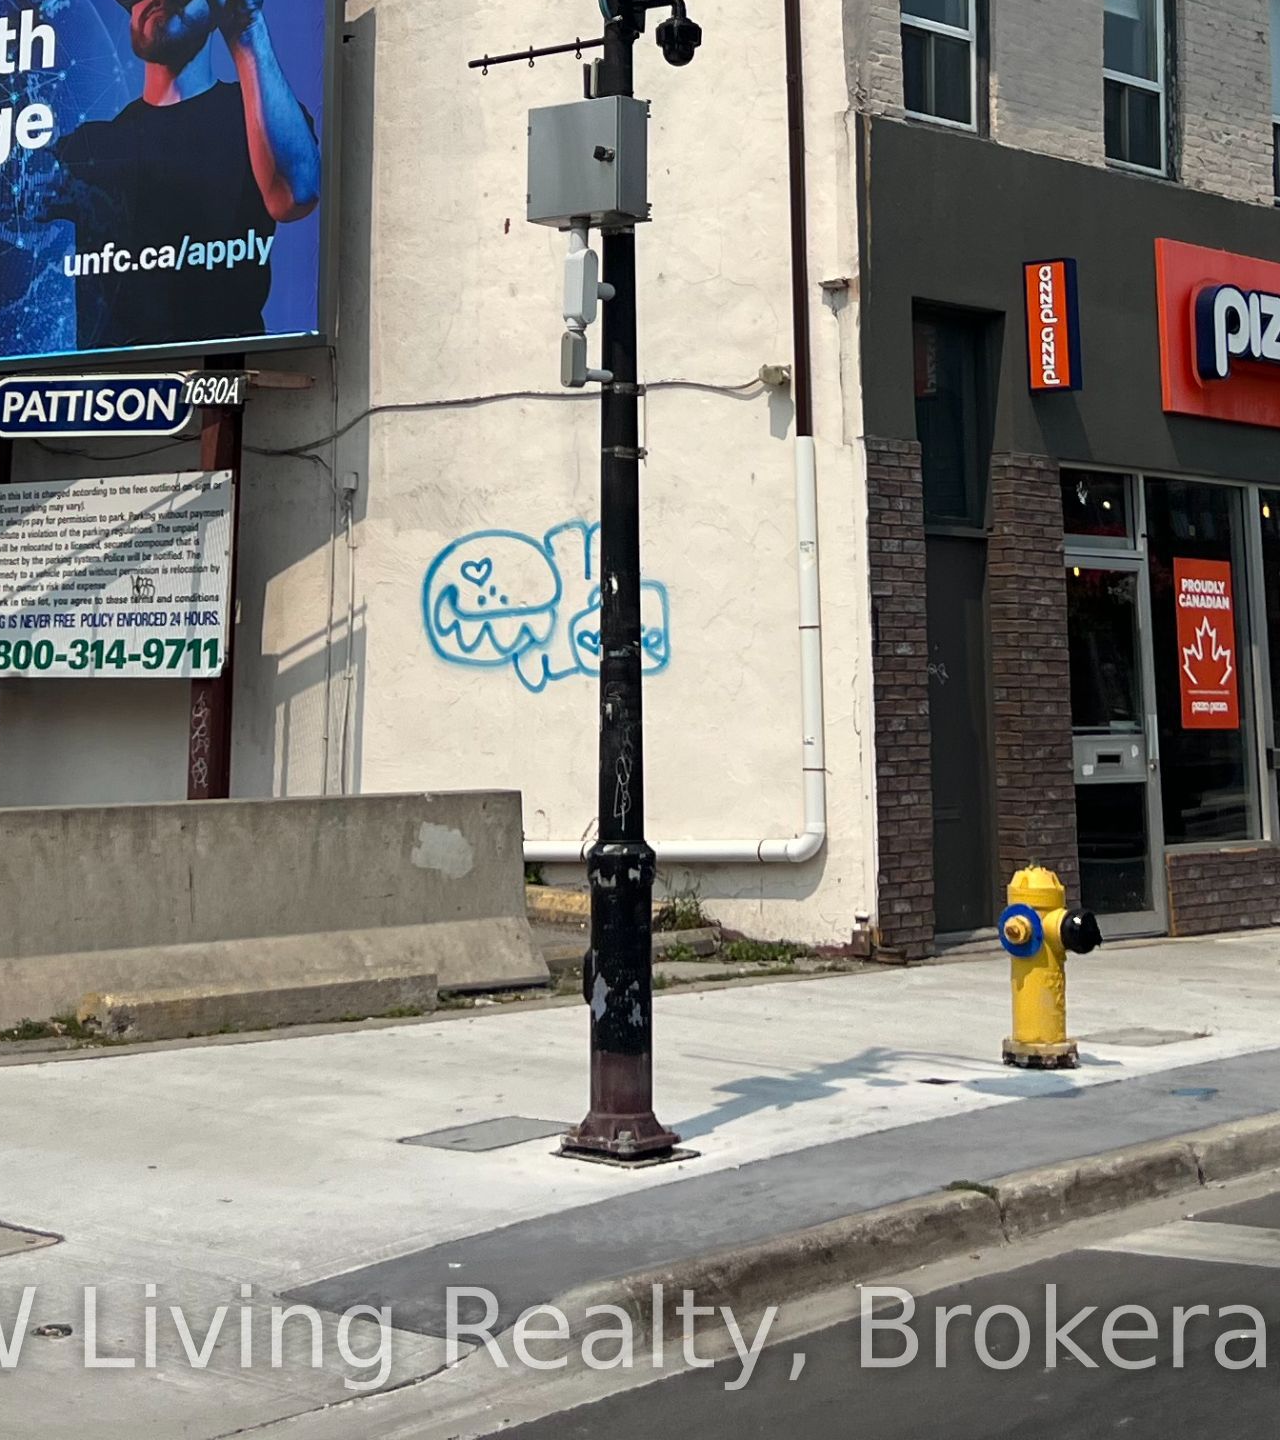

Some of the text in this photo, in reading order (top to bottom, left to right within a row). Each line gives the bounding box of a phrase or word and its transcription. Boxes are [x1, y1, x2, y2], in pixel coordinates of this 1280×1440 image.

[64, 230, 273, 279] unfc.ca/apply
[1040, 265, 1060, 385] pizza pizza
[2, 377, 239, 422] PATTISON 1630A
[109, 487, 117, 495] to
[119, 485, 131, 494] the
[1181, 578, 1225, 593] PROUDLY
[1179, 593, 1230, 609] CANADIAN
[8, 614, 17, 628] IS
[20, 614, 51, 628] NEVER
[54, 613, 75, 628] FREE
[80, 613, 114, 627] POLICY
[117, 612, 167, 627] ENFORCED
[170, 612, 180, 626] 24
